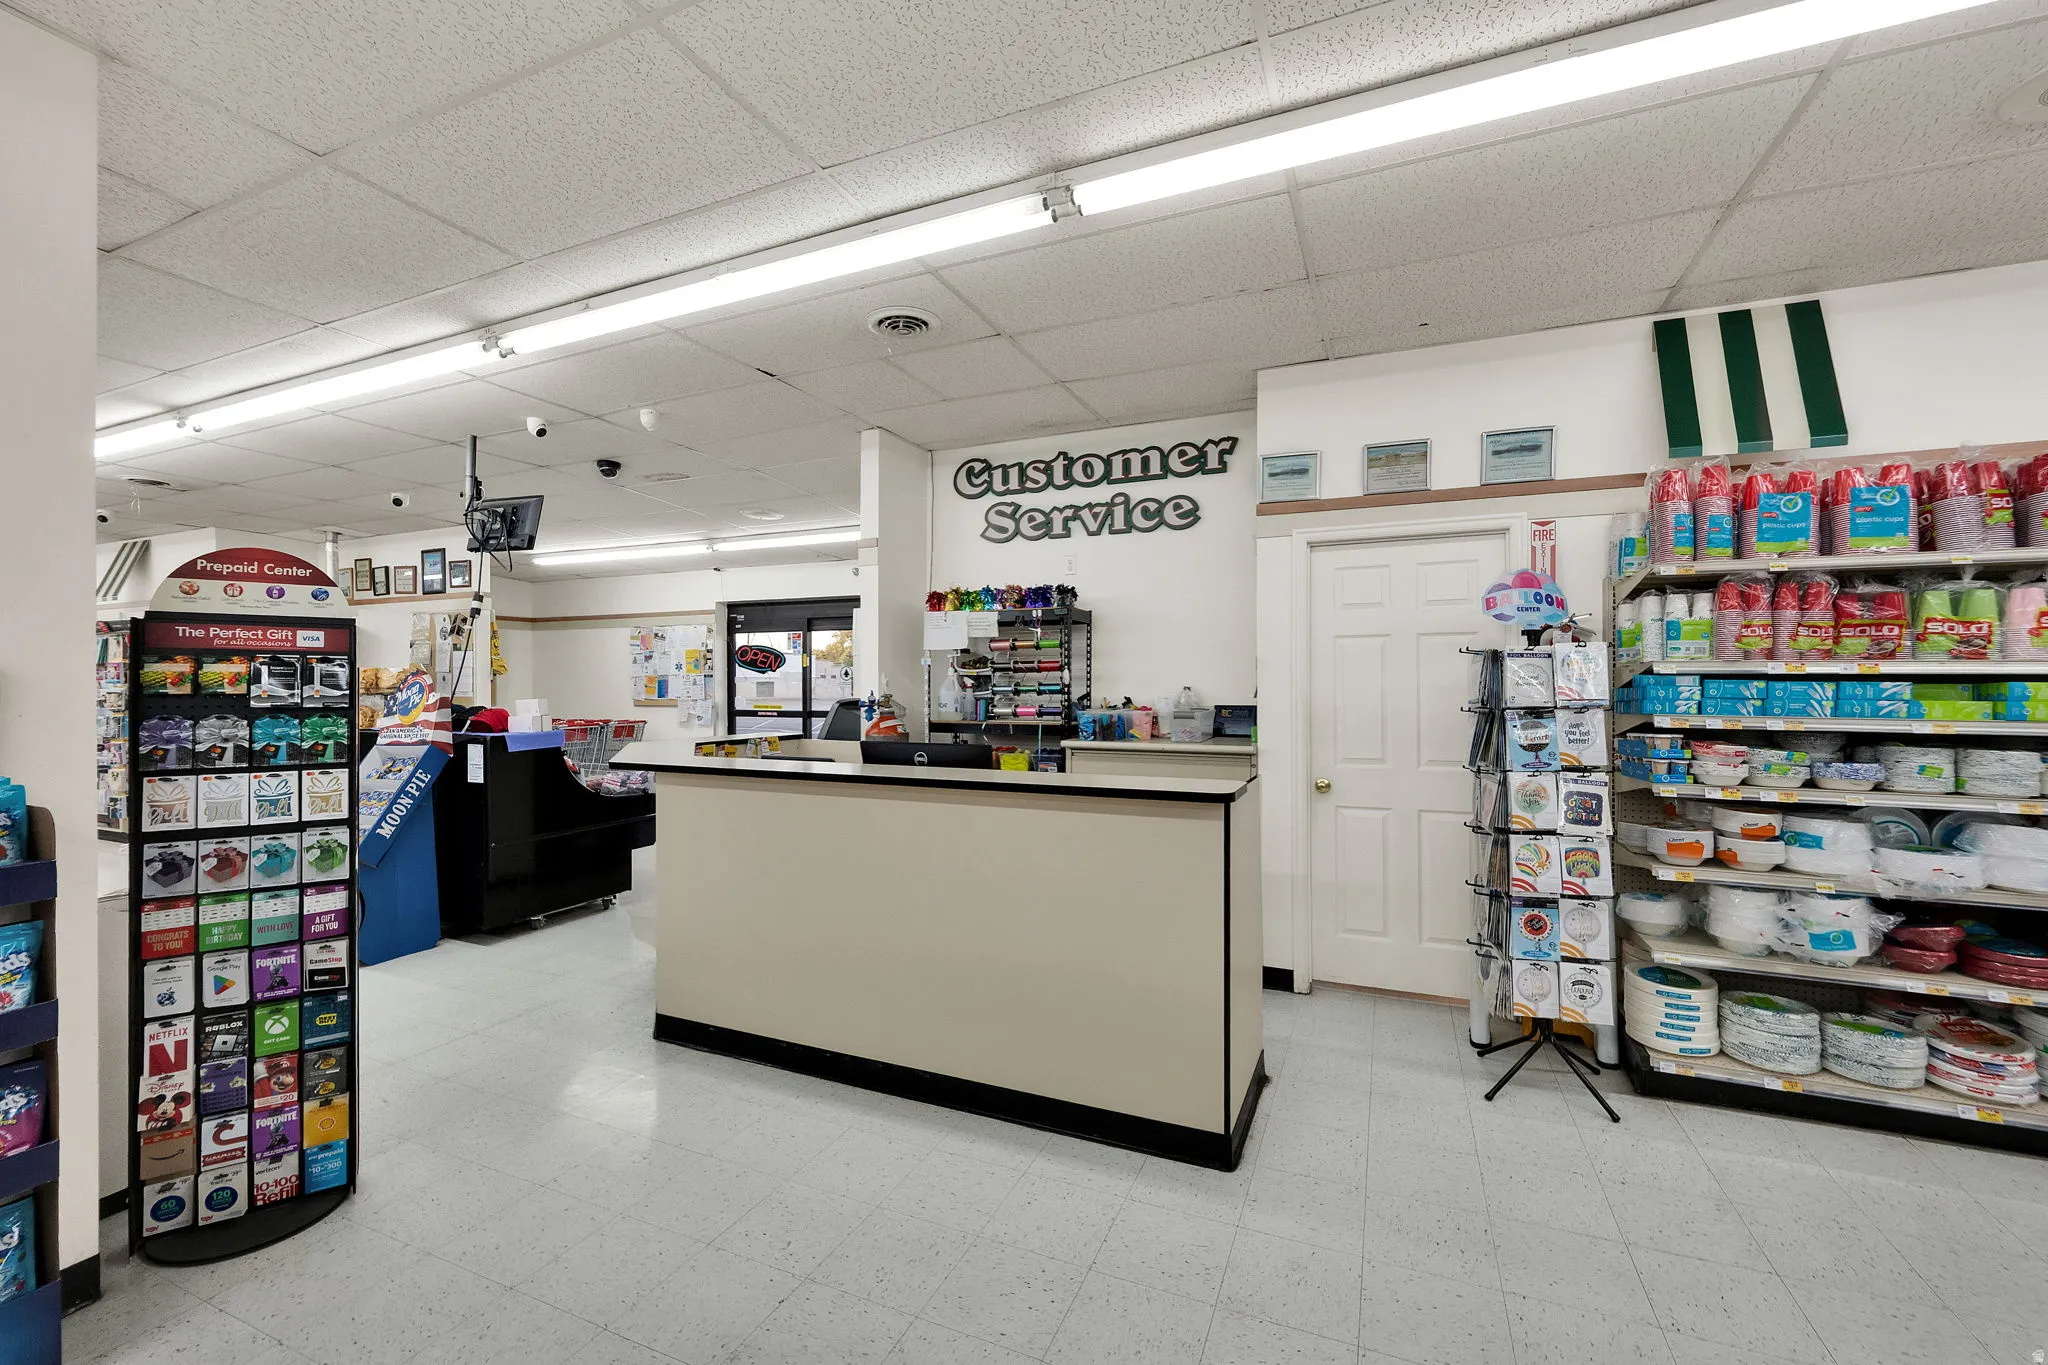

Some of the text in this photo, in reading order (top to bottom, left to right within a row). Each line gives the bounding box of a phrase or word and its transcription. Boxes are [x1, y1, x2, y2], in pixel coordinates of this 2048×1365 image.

[954, 436, 1239, 499] Customer
[980, 492, 1200, 544] Service
[1532, 528, 1554, 542] FIRE
[196, 559, 312, 577] Prepaid Center
[1485, 591, 1565, 611] BALLOON
[175, 626, 293, 640] The Perfect Gift
[1840, 626, 1900, 636] SOLO
[1926, 622, 1988, 634] SOLO
[213, 638, 226, 646] for
[230, 638, 246, 646] all
[738, 646, 781, 670] OPEN
[396, 684, 420, 704] Moon
[408, 694, 422, 708] Pie
[1570, 852, 1594, 860] GOOD
[315, 914, 335, 924] A GIFT
[257, 922, 294, 933] WITH LOVE
[312, 921, 338, 933] FOR YOU
[146, 931, 189, 943] CONGRATS
[153, 941, 183, 951] TO YOU!
[256, 954, 296, 968] FORTNITE
[310, 957, 342, 965] GameStop
[206, 1021, 243, 1032] ROBLOX
[149, 1027, 188, 1042] NETFLIX
[145, 1082, 184, 1093] Disney
[256, 1111, 297, 1129] FORTNITE
[256, 1166, 280, 1175] verizon
[213, 1190, 231, 1201] 120
[256, 1184, 297, 1204] Refill
[161, 1200, 176, 1210] 60
